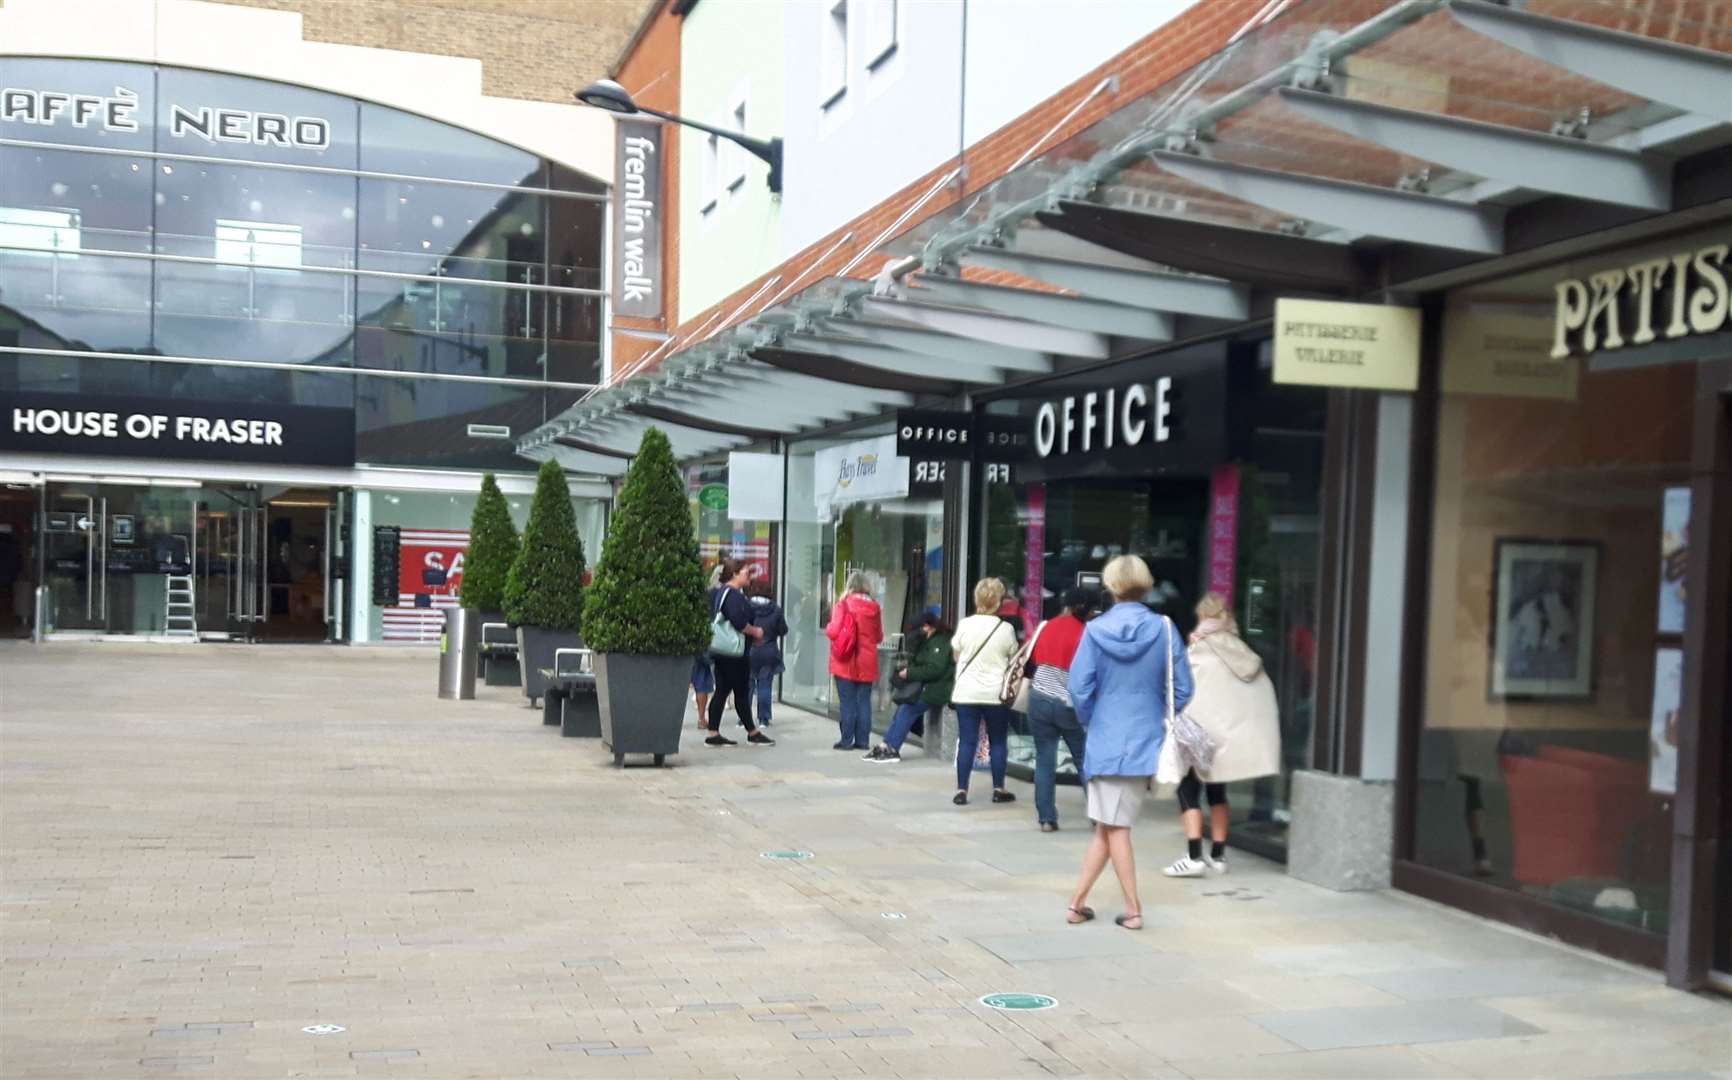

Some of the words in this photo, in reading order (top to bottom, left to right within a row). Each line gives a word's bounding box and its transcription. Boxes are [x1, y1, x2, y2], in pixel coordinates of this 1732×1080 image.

[170, 104, 330, 150] NERO
[624, 137, 655, 232] fremlin
[624, 238, 652, 301] walk
[1550, 244, 1732, 359] PATIS
[13, 408, 118, 437] HOUSE
[125, 414, 169, 440] OF
[176, 416, 283, 446] FRASER
[902, 426, 969, 443] OFFICE
[1036, 376, 1172, 457] OFFICE
